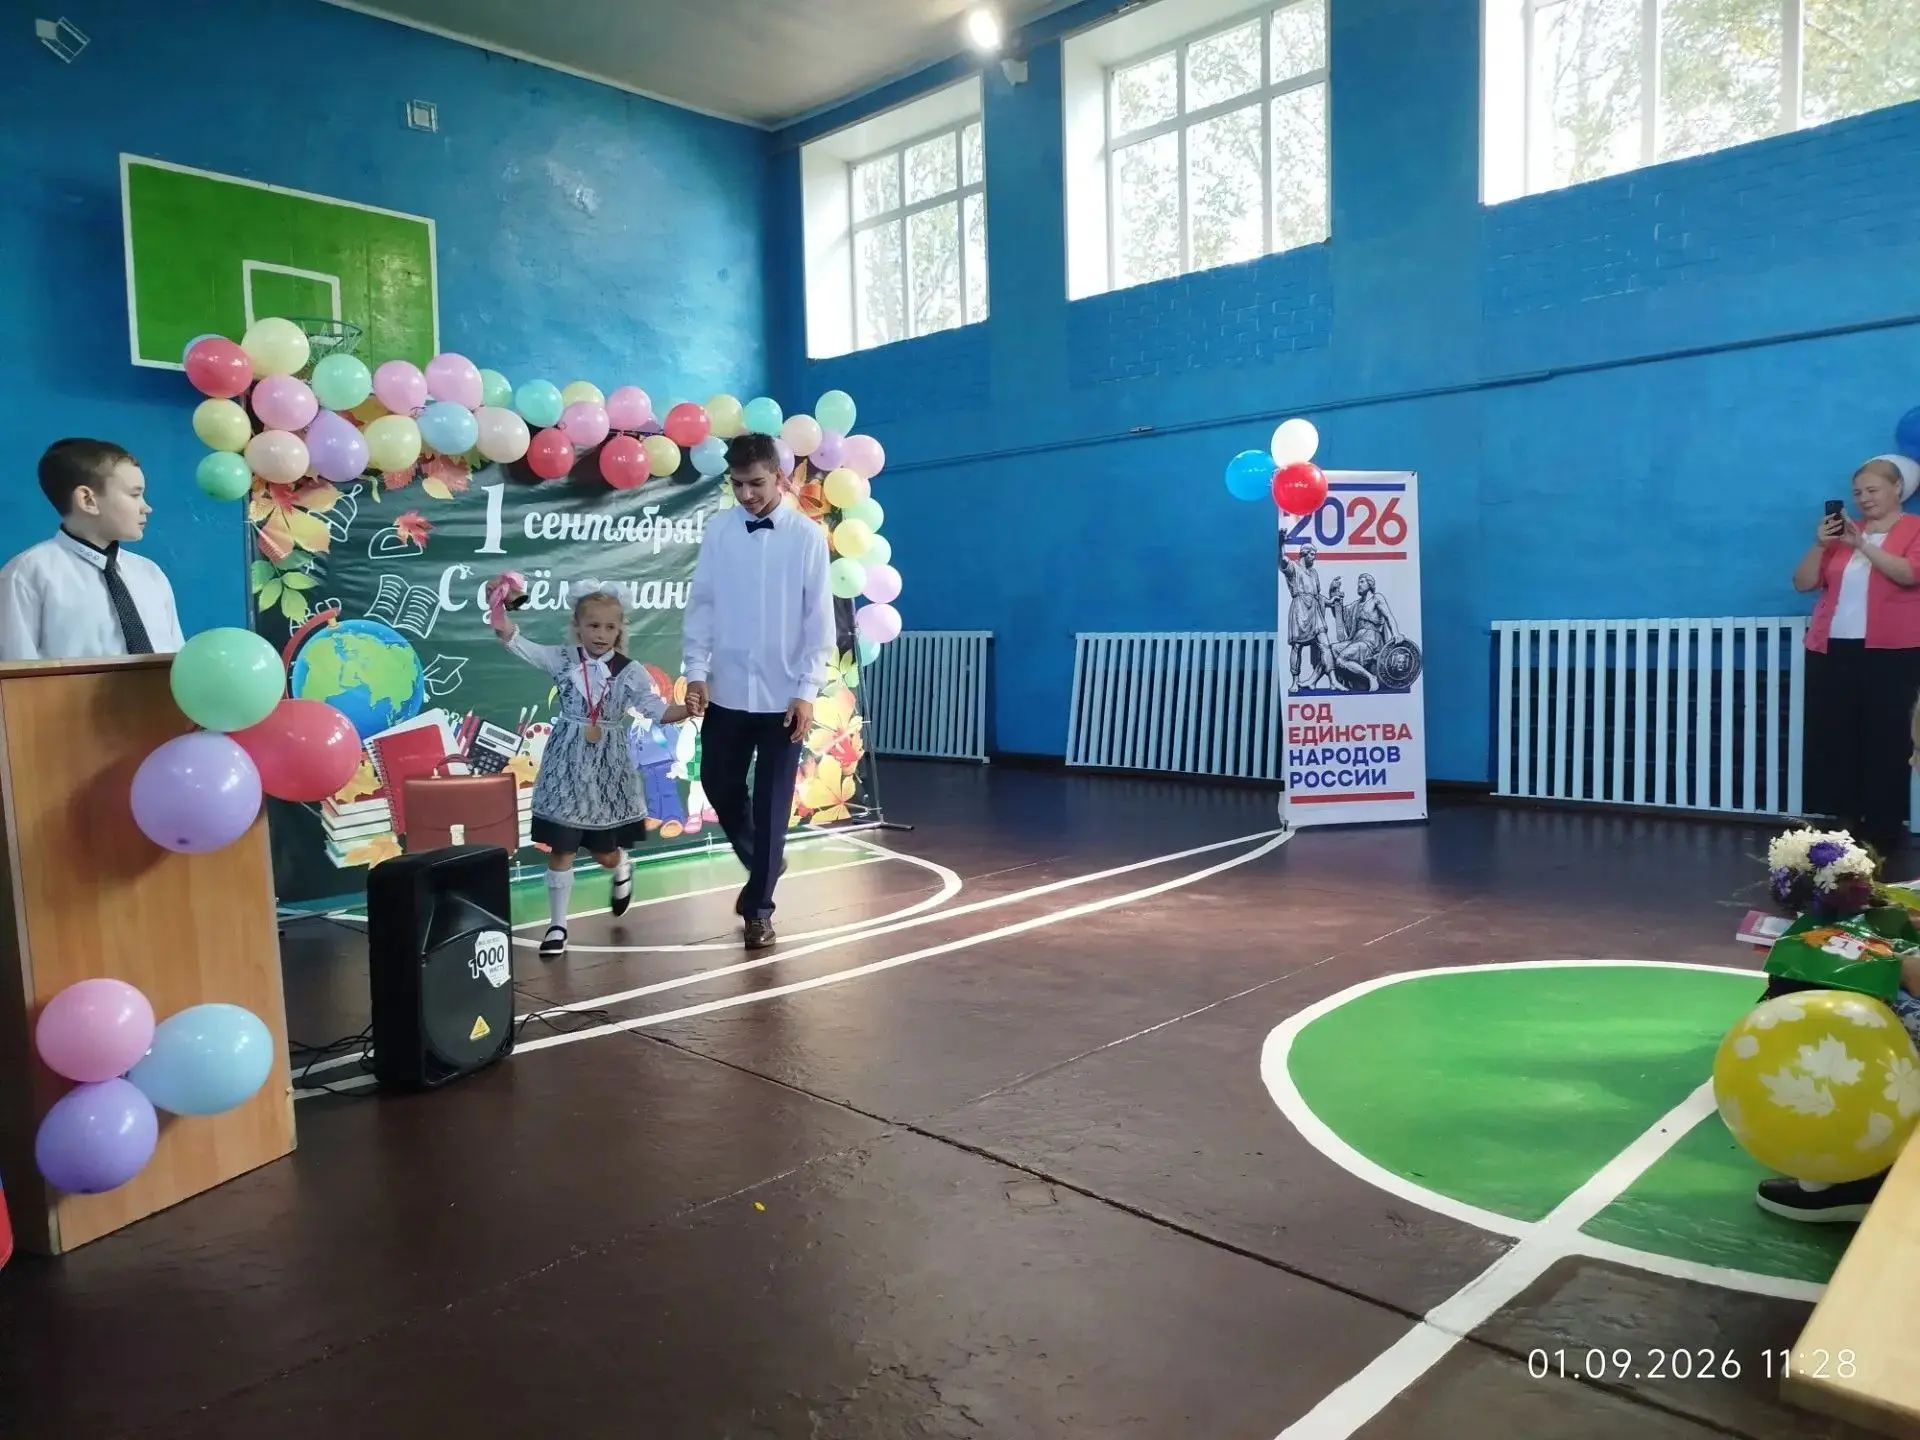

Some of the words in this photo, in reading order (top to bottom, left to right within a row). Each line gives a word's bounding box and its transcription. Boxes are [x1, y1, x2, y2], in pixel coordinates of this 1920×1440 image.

[474, 482, 508, 554] 1
[523, 504, 705, 555] сентября!
[1283, 496, 1408, 546] 2026
[438, 564, 469, 612] С
[1288, 703, 1333, 723] ГОД
[1288, 723, 1413, 747] ЕДИНСТВА
[1289, 746, 1401, 767] НАРОДОВ
[1289, 768, 1387, 789] РОССИИ
[469, 945, 505, 977] 1000
